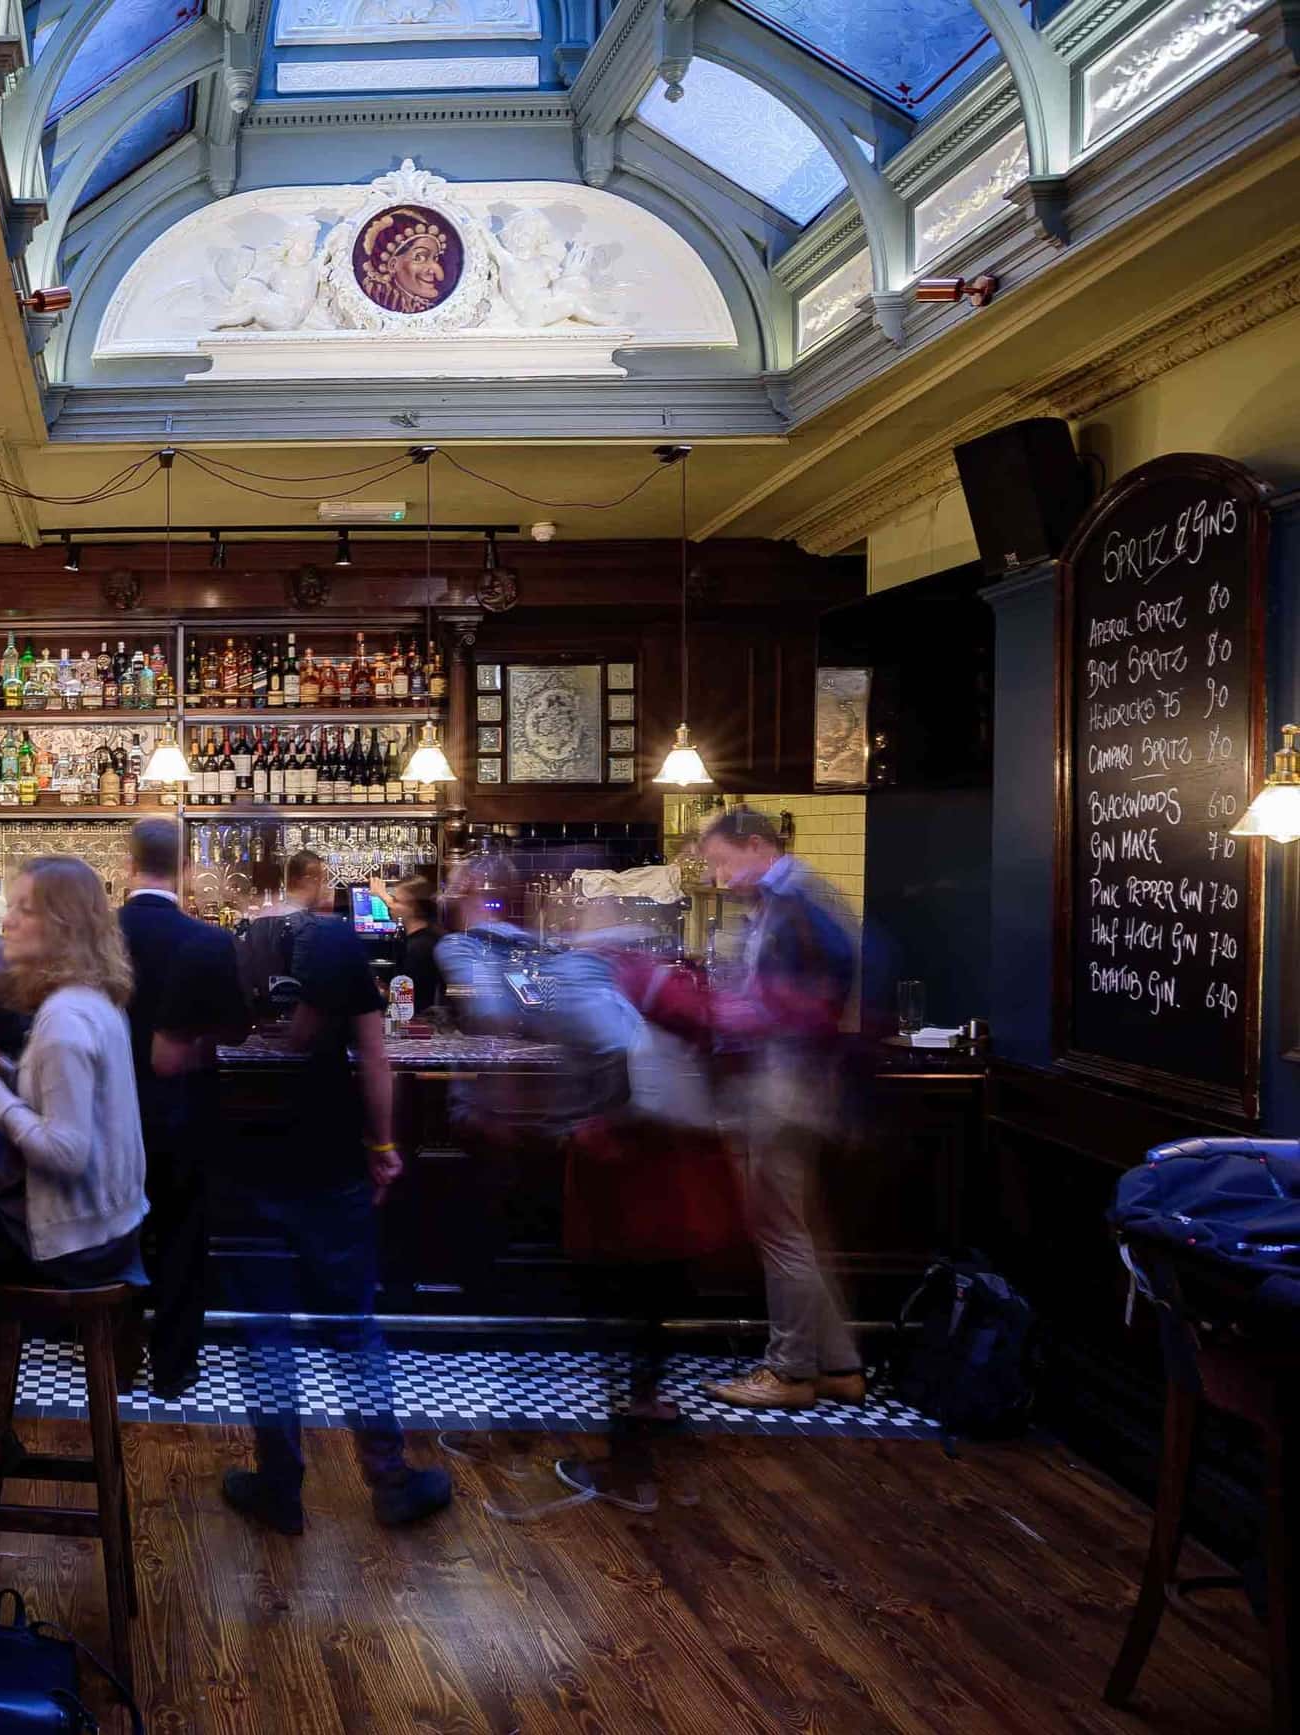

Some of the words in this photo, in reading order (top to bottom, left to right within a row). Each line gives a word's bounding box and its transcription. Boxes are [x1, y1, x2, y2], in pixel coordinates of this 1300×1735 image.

[1104, 525, 1169, 583] SPRITZ
[1188, 499, 1237, 564] GINS
[1089, 618, 1134, 648] APEROL
[1137, 596, 1187, 632] SPRITZ
[1087, 659, 1119, 699] BRIT
[1128, 645, 1188, 683] SPRITZ
[1089, 698, 1155, 732] HENDRICKS
[1088, 744, 1133, 774] CAMPARI
[1142, 737, 1192, 770] SPRITZ
[1089, 788, 1182, 825] BLACKWOODS
[1090, 832, 1115, 876] GIN
[1121, 828, 1162, 864] MARE
[1090, 878, 1120, 909] PINK
[1127, 876, 1178, 913] PEPPER
[1180, 878, 1203, 912] GIN
[1172, 922, 1197, 965] GIN
[1089, 961, 1143, 1000] BATHTUB
